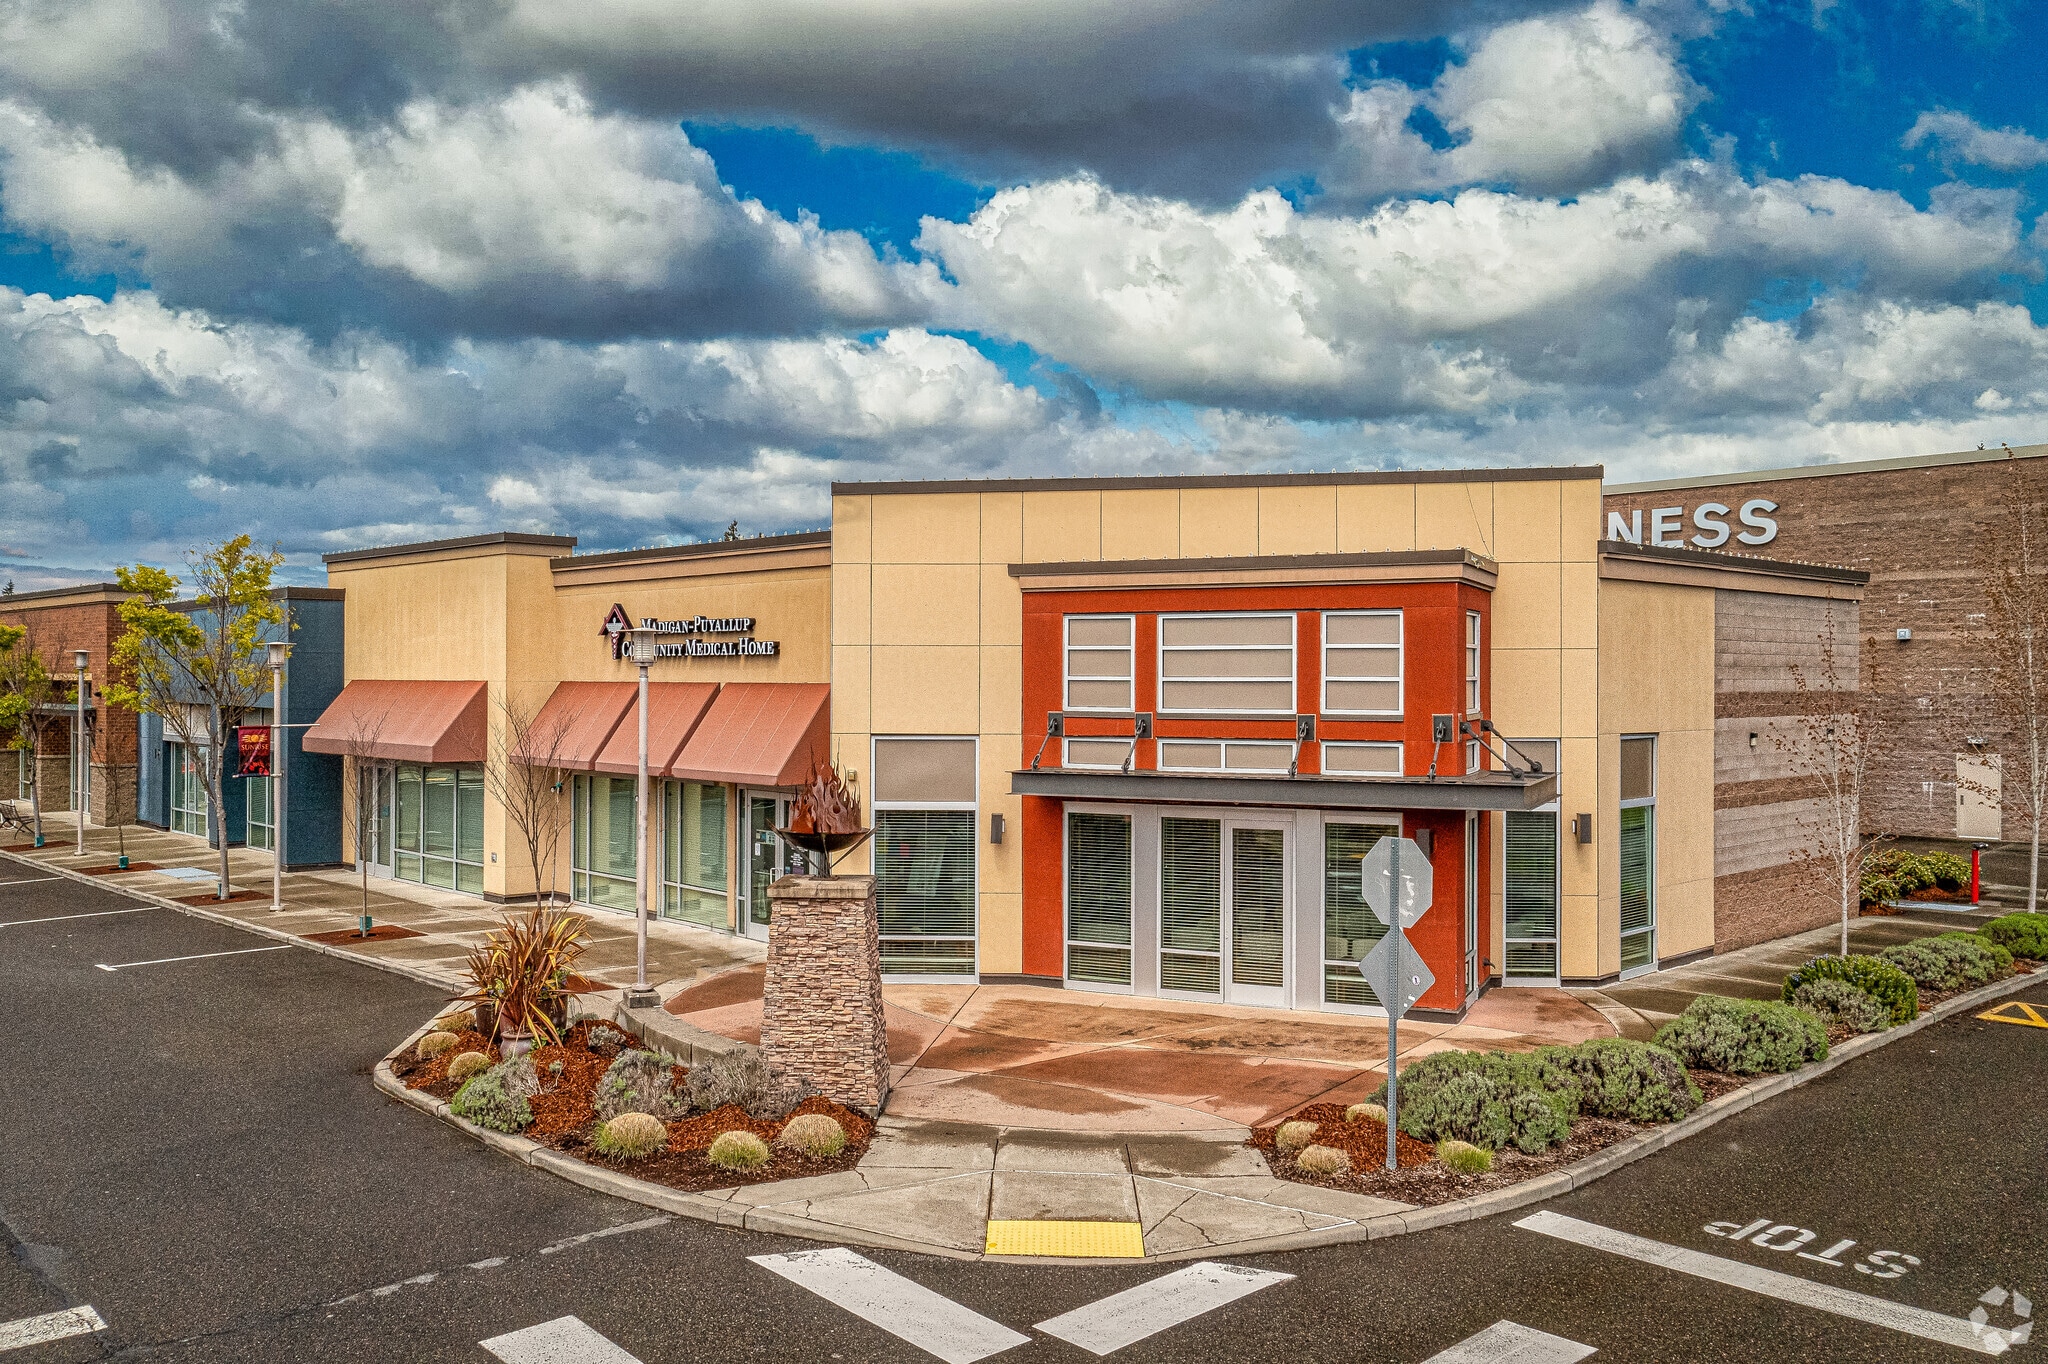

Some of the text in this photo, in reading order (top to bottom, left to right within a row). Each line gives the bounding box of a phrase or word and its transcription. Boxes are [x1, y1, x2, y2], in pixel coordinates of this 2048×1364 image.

[1607, 499, 1779, 548] NESS
[621, 637, 775, 658] COUNITY MEDICAL HOME
[1703, 1218, 1922, 1279] STOP
